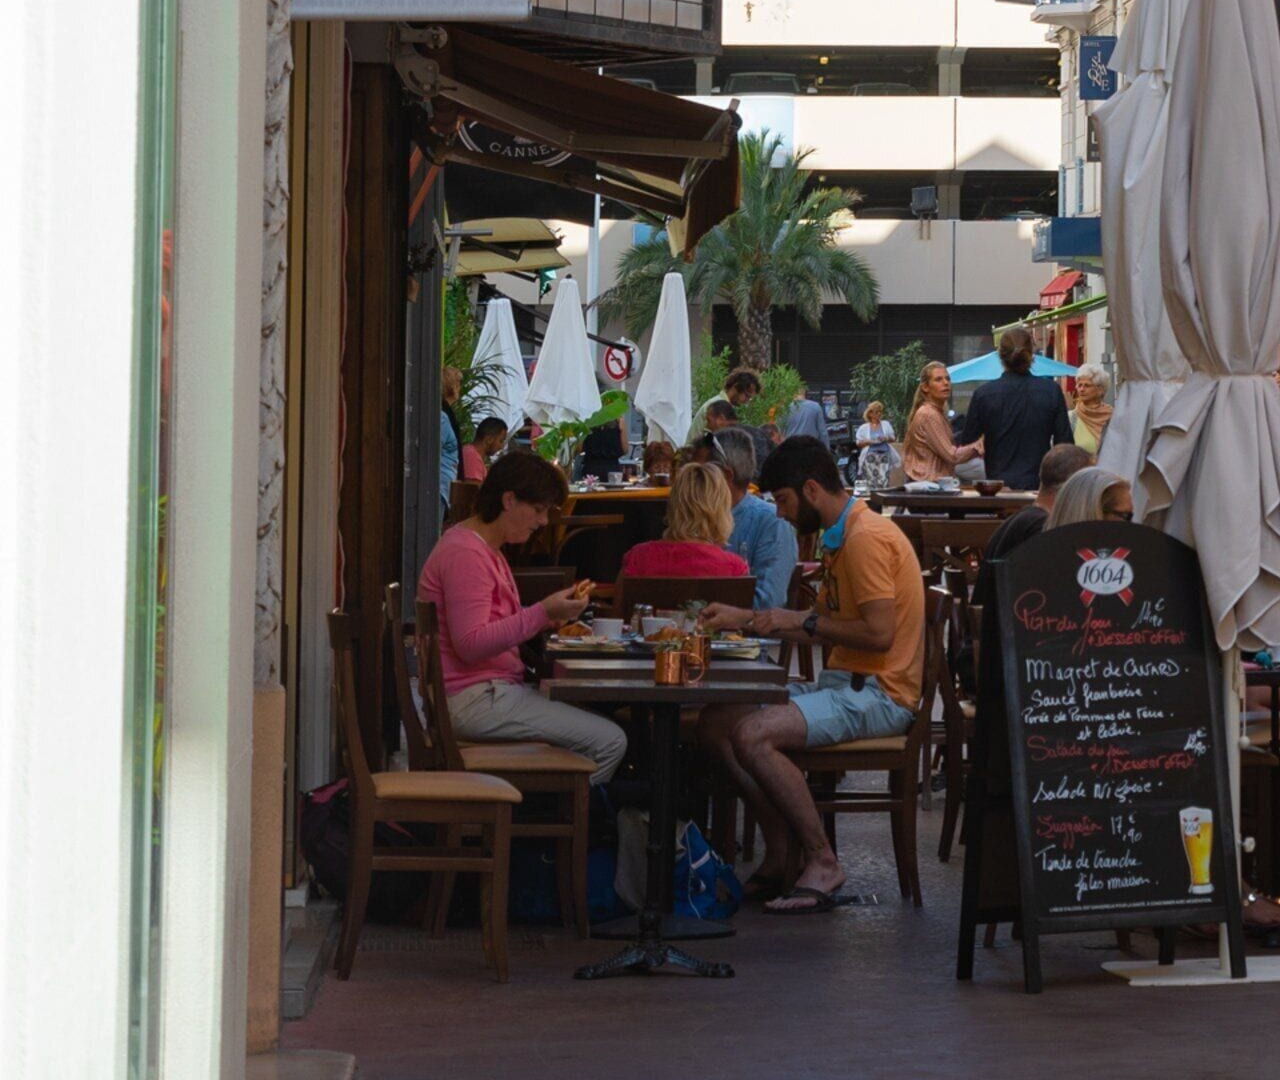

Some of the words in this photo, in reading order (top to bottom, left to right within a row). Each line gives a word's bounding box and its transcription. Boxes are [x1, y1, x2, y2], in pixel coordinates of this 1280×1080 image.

[489, 142, 556, 158] CANNE
[1083, 563, 1127, 585] 1664
[1102, 660, 1122, 678] de
[1031, 689, 1078, 709] Sauce
[1075, 851, 1091, 869] de
